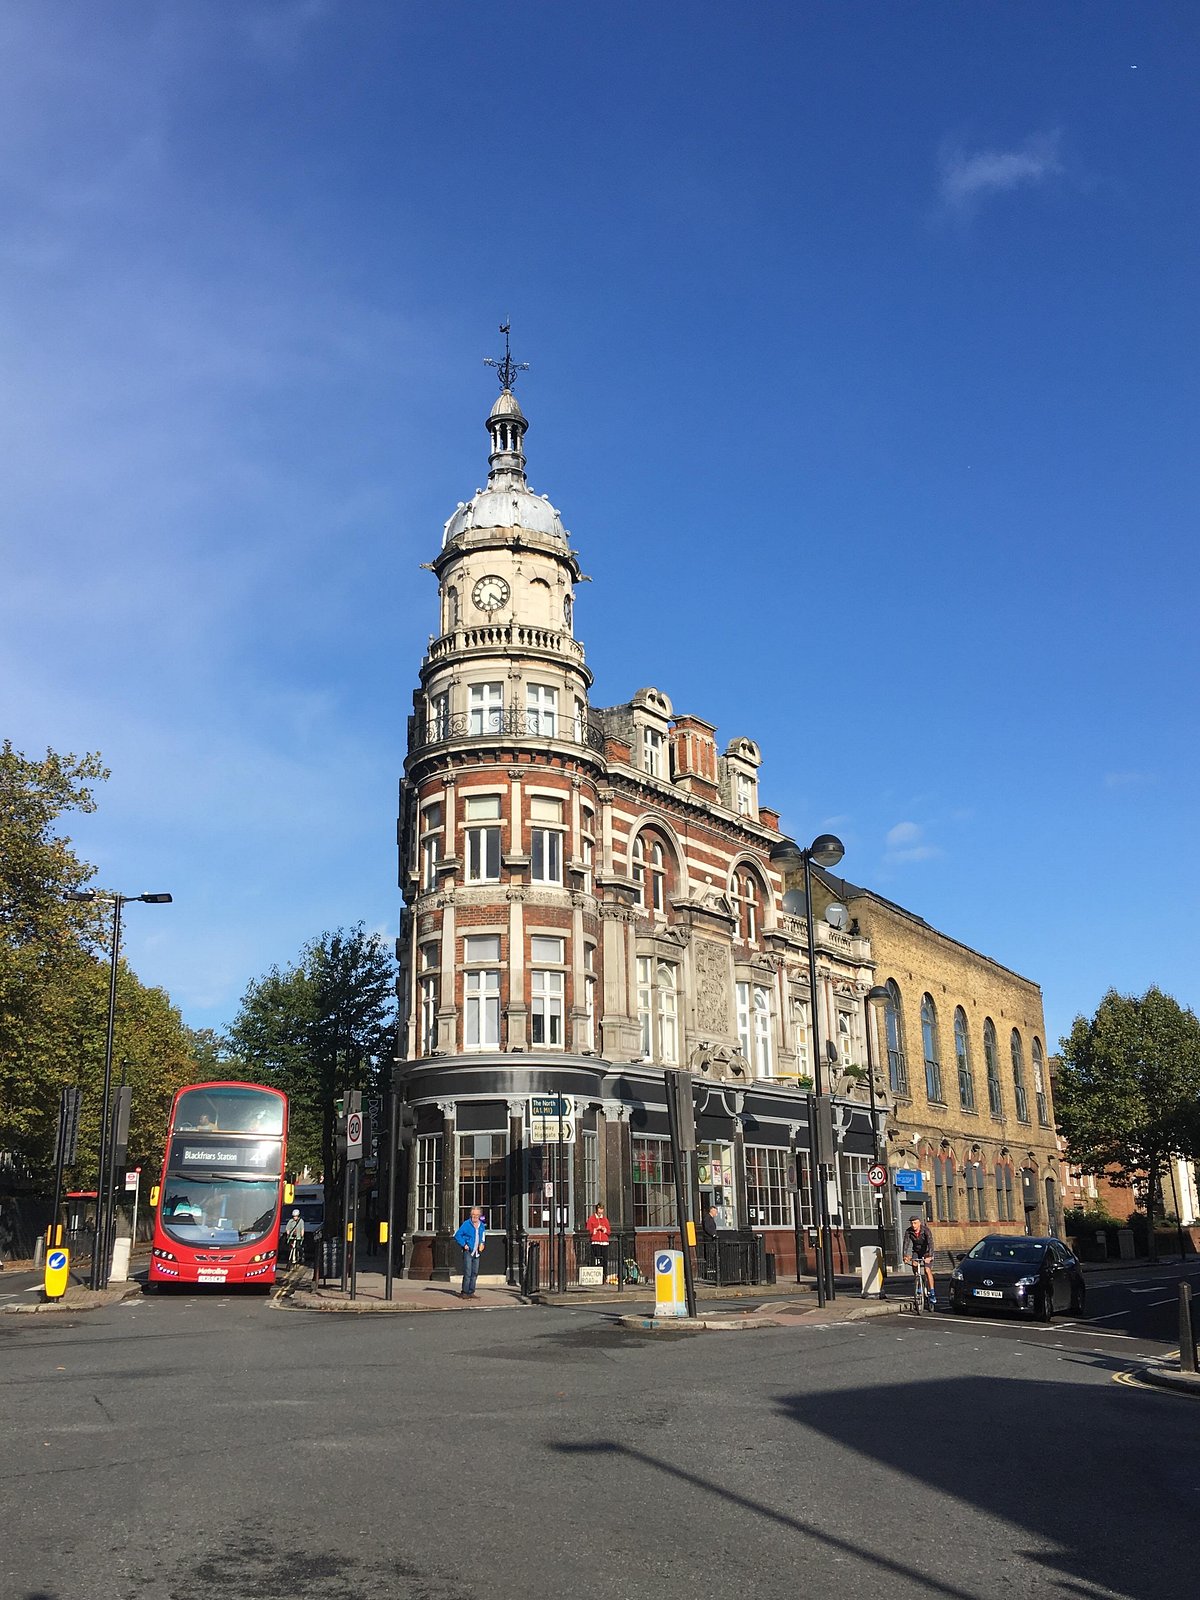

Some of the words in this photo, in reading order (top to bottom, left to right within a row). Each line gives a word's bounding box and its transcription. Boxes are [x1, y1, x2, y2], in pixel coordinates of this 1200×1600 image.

[350, 1122, 359, 1134] 20
[184, 1150, 216, 1160] Blackfriars
[217, 1152, 238, 1161] Station
[870, 1170, 883, 1180] 20
[197, 1266, 229, 1275] Metroline
